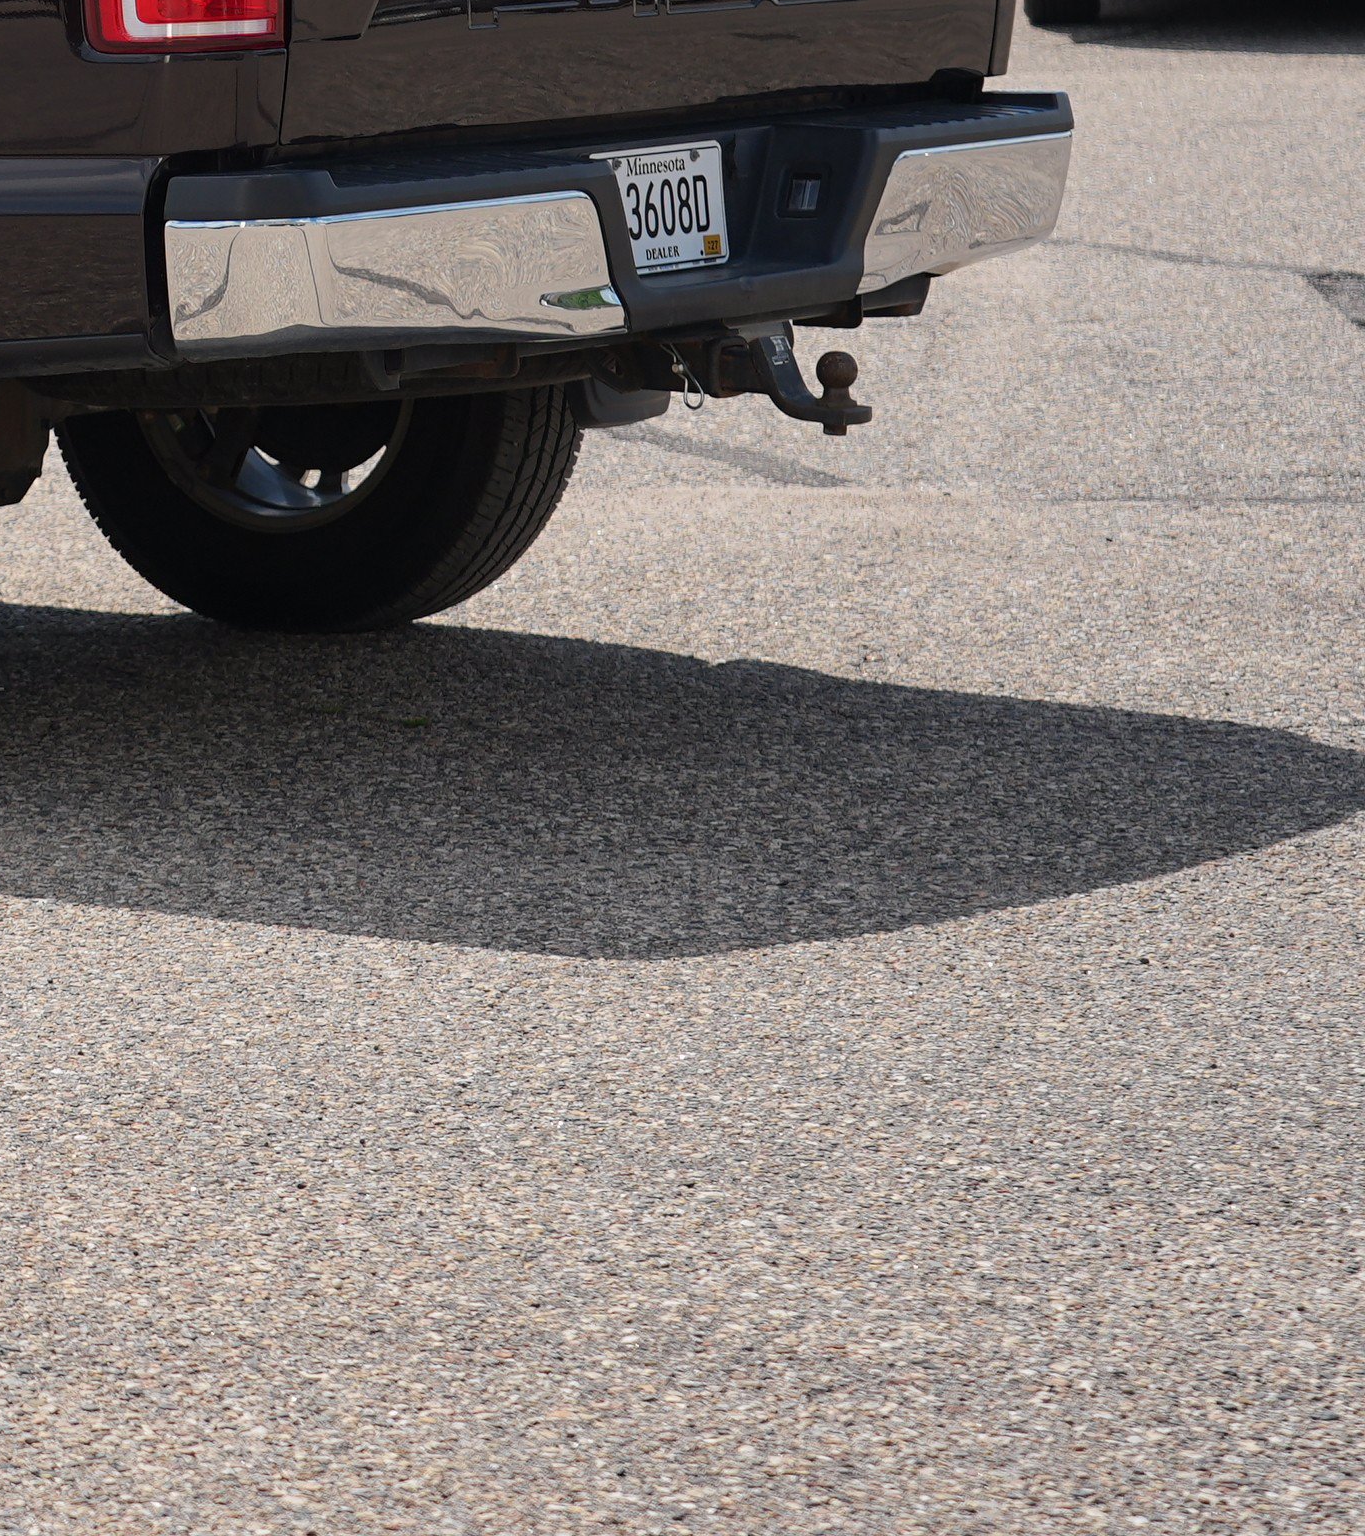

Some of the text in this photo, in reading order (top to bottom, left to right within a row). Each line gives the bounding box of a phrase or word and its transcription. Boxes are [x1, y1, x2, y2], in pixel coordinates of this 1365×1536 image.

[626, 156, 685, 176] Minnesota
[626, 175, 711, 241] 3608D
[645, 245, 680, 261] DEALER
